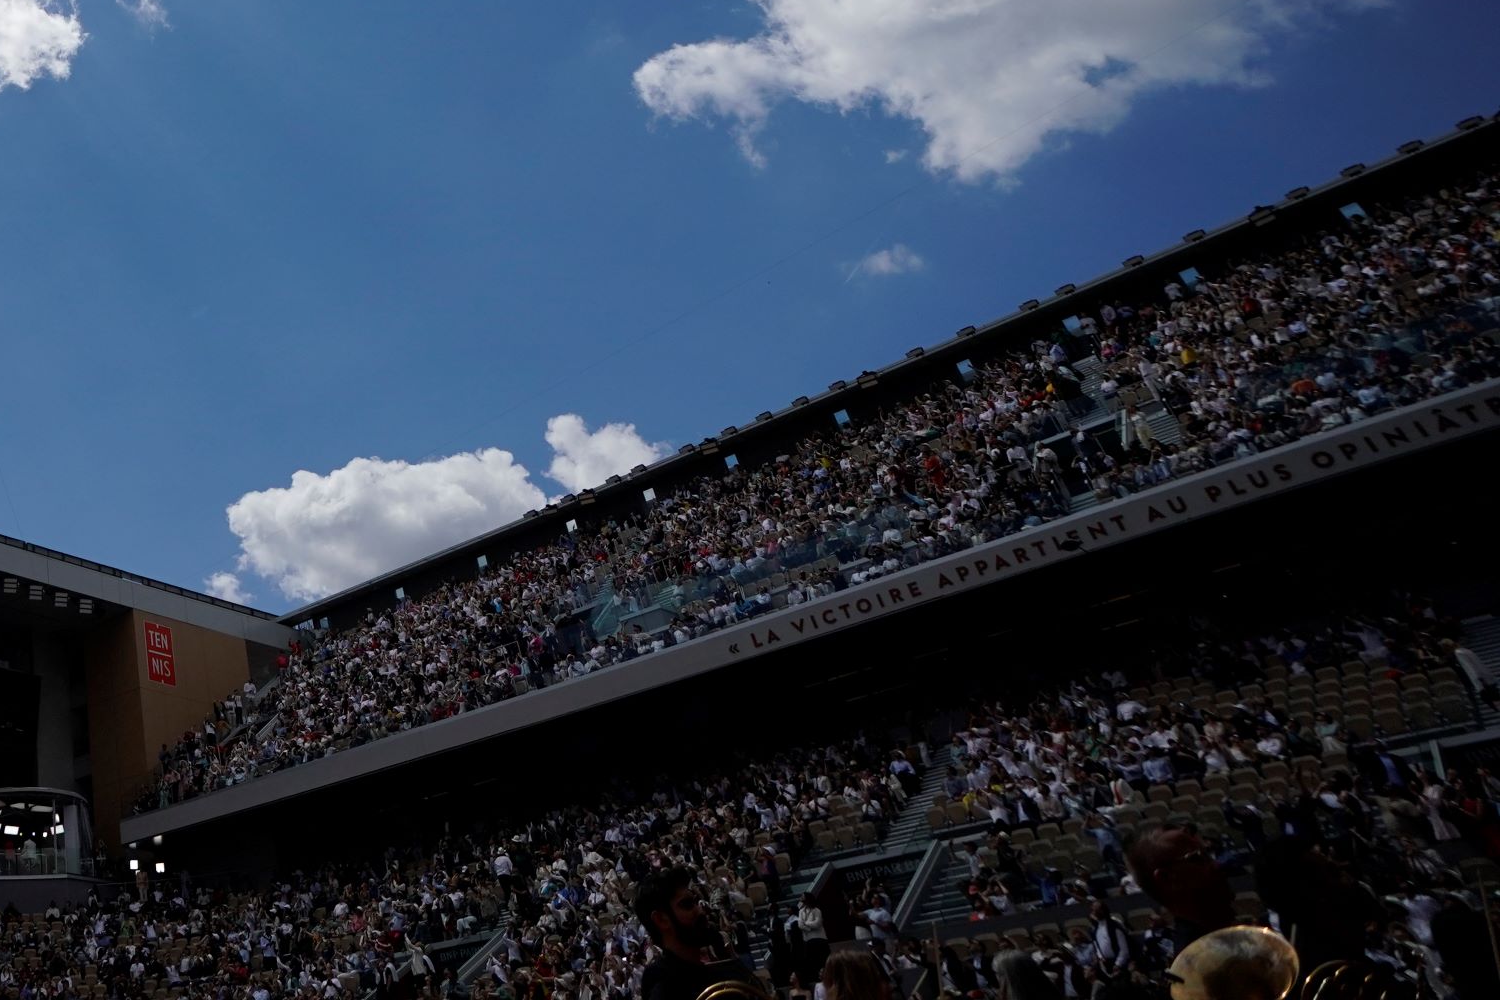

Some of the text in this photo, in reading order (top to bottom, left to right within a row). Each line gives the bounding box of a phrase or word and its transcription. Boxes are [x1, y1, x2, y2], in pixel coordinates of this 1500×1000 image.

[750, 629, 781, 648] LA
[791, 581, 922, 633] VICTOIRE
[1148, 496, 1187, 522] AU
[1204, 464, 1292, 502] PLUS
[148, 630, 168, 650] TEN
[152, 657, 171, 677] NIS
